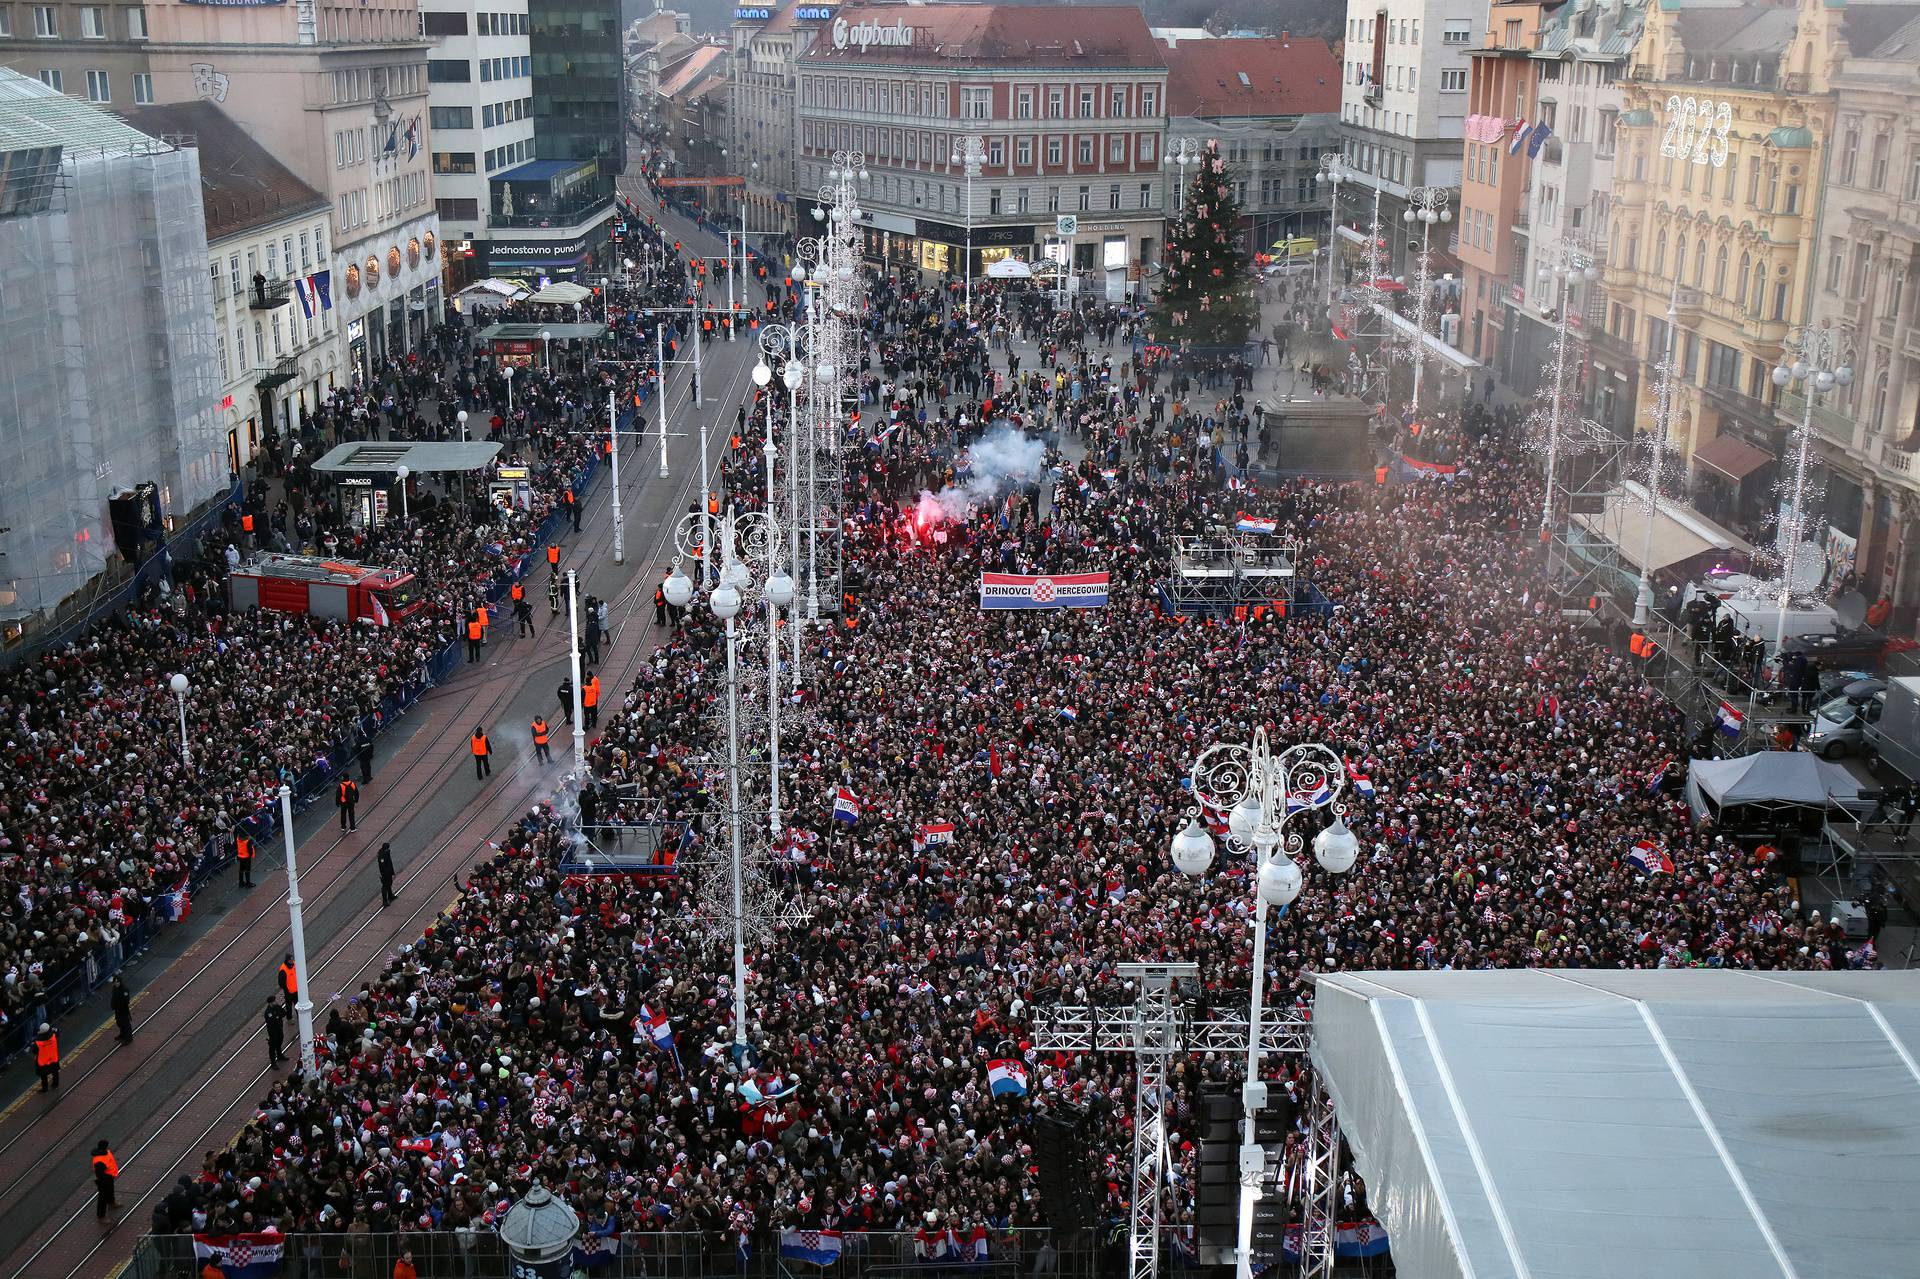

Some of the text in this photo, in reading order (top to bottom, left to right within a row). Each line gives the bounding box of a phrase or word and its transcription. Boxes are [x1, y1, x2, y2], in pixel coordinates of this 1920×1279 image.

[1660, 95, 1731, 167] 2023
[1087, 224, 1125, 232] HOLDING
[988, 231, 1013, 240] ZAKS
[489, 245, 551, 255] Jednostavno
[554, 246, 575, 256] puno
[985, 585, 1108, 595] DRINOVCI HERCEGOVINA
